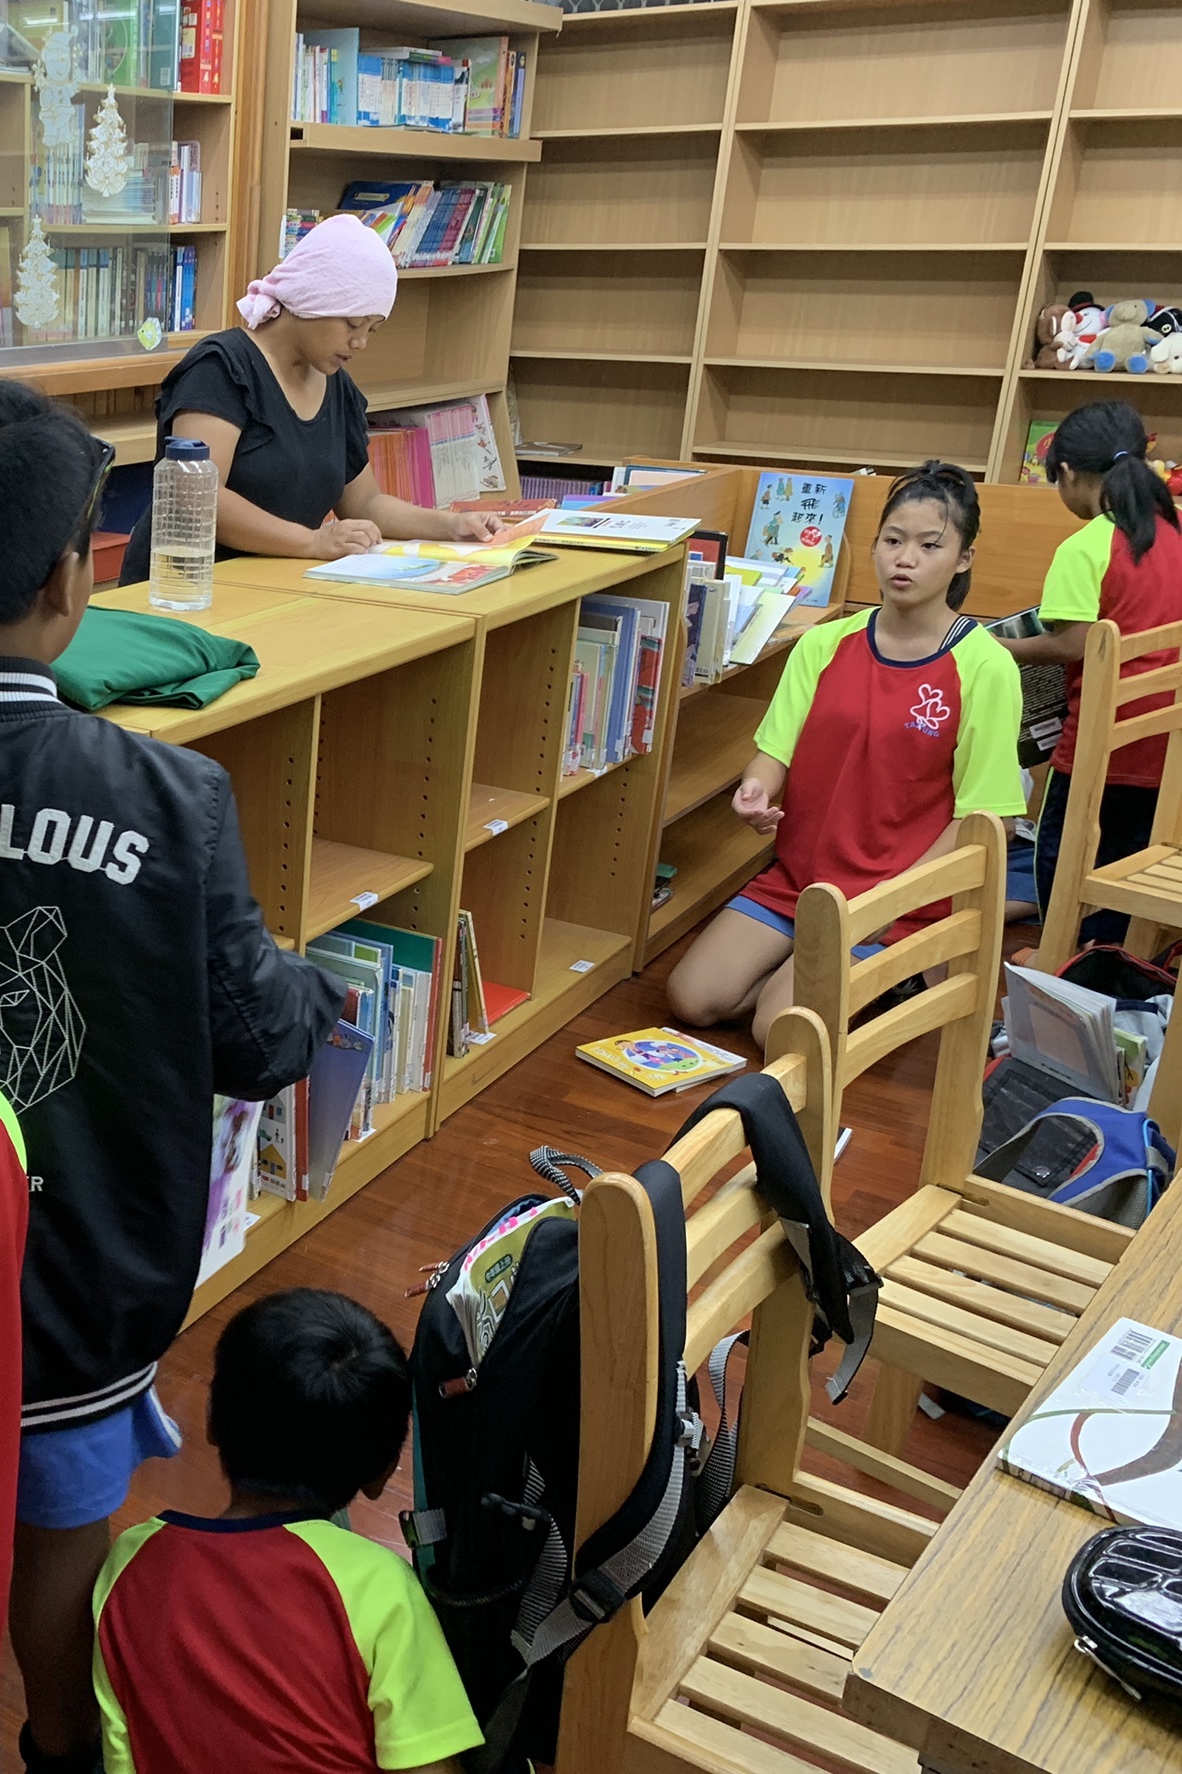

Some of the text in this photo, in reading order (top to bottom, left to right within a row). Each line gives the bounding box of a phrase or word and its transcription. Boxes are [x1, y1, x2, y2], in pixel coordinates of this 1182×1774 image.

[801, 482, 827, 494] 重新
[800, 498, 821, 510] 飛
[26, 1176, 44, 1192] R
